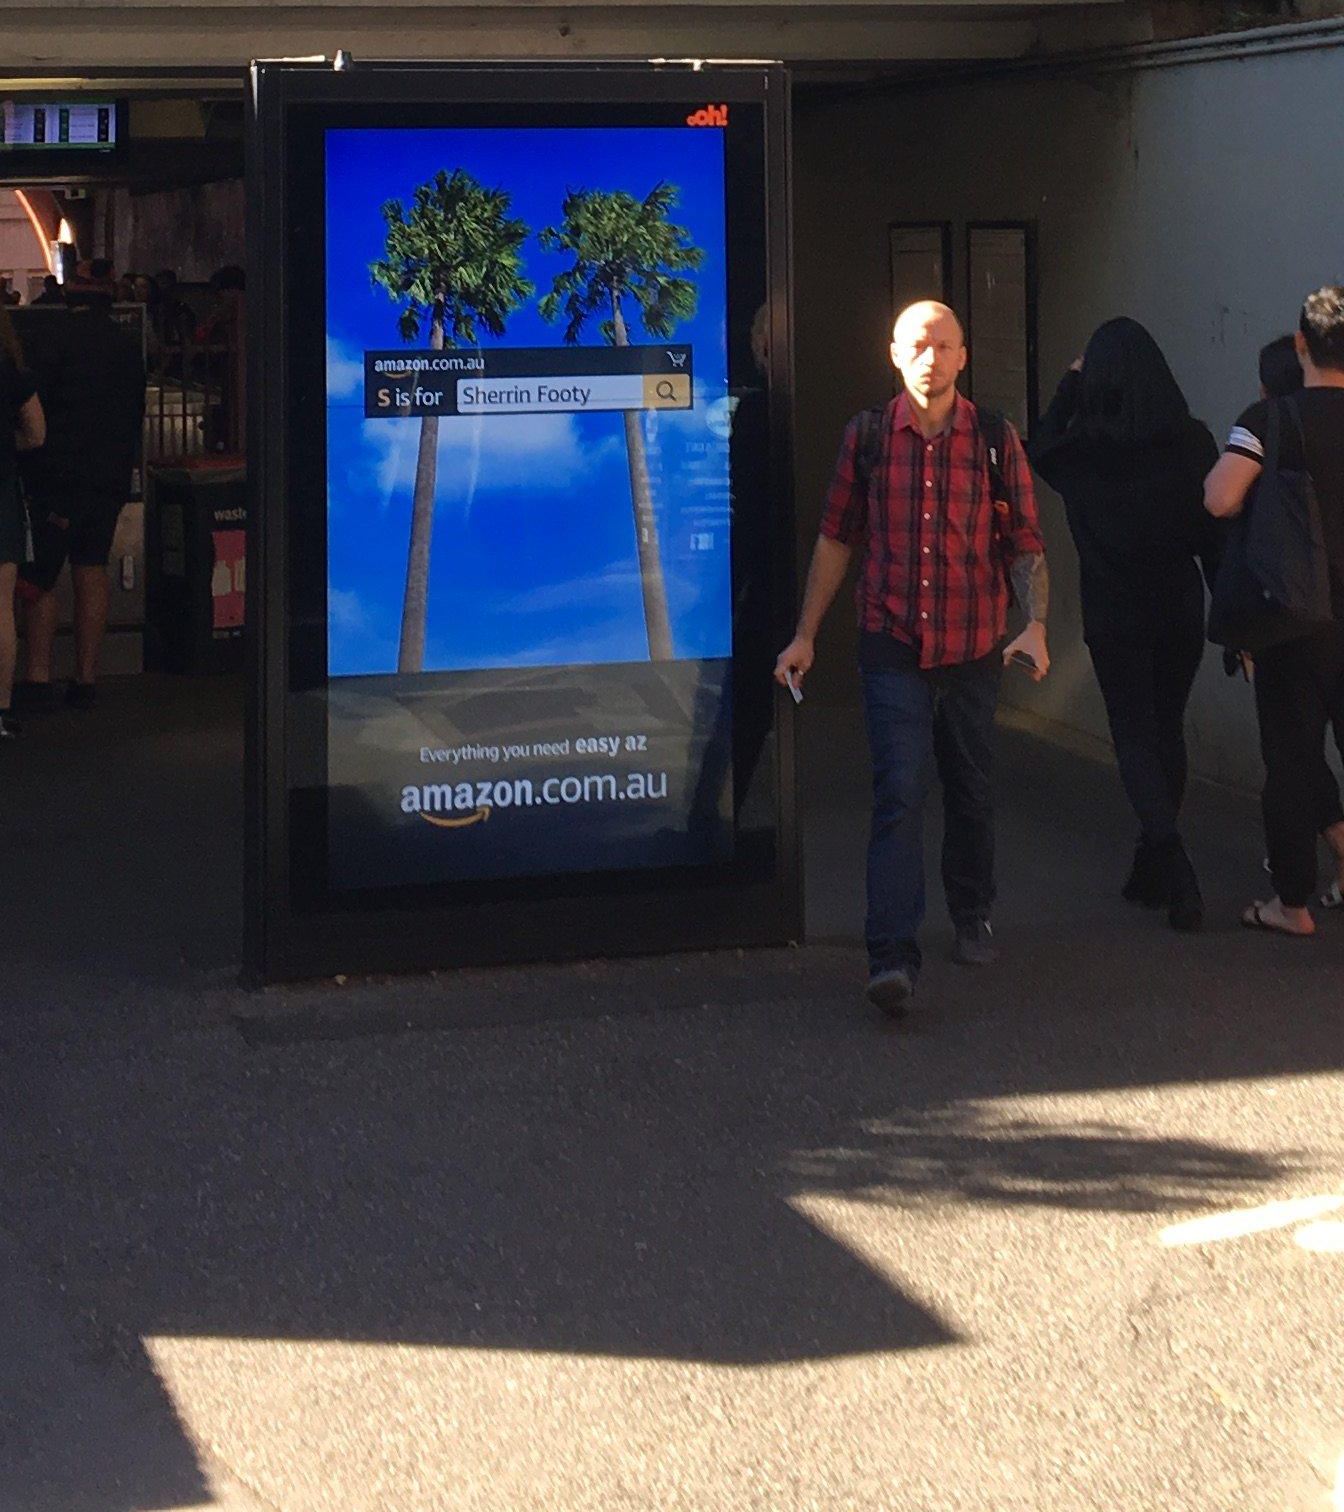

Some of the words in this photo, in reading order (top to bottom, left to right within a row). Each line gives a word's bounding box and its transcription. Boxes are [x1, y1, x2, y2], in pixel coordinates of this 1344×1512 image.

[374, 356, 485, 373] amazon.com.au
[377, 388, 391, 408] S
[395, 388, 411, 407] is
[414, 387, 444, 407] for
[462, 386, 532, 406] Sherrin
[537, 385, 591, 407] Footy
[419, 744, 499, 765] Everything
[502, 743, 531, 761] you
[533, 739, 570, 757] need
[575, 734, 621, 757] easy
[624, 734, 648, 752] az
[400, 771, 668, 813] amazon.com.au
